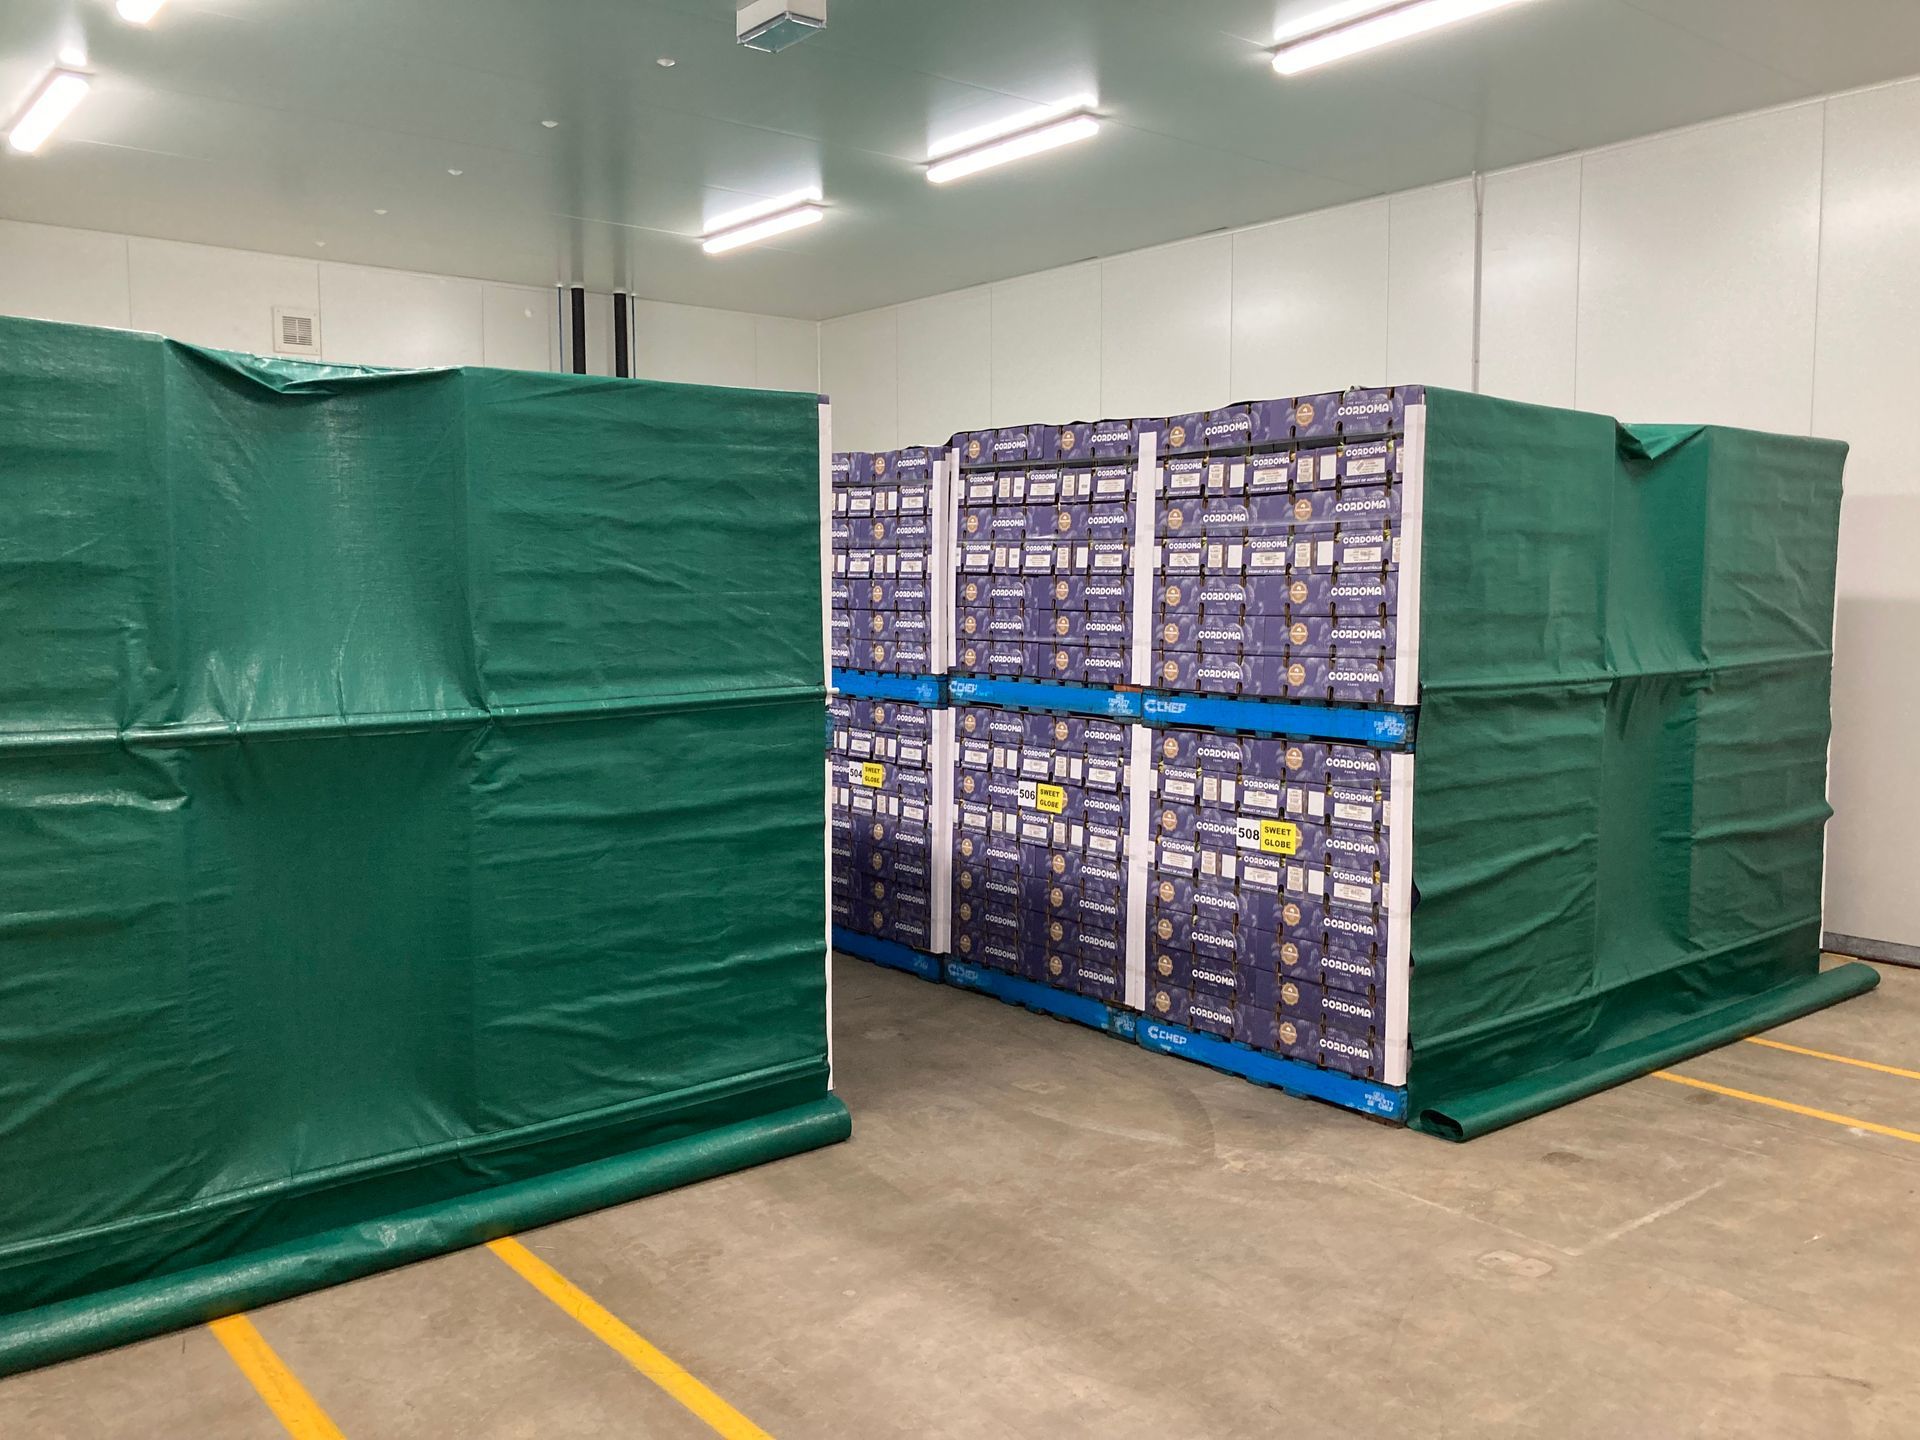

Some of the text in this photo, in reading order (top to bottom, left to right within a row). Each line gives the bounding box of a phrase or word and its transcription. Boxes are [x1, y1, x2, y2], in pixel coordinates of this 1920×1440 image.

[1338, 403, 1389, 416] CORDOMA
[1205, 421, 1248, 436] CORDOMA
[1092, 432, 1128, 442] CORDOMA
[995, 441, 1026, 450] CORDOMA
[1346, 446, 1386, 457] CORDOMA
[1254, 456, 1289, 467] CORDOMA
[1336, 500, 1386, 512] CORDOMA
[1088, 516, 1124, 524] CORDOMA
[1203, 513, 1245, 522] CORDOMA
[1169, 541, 1201, 549] CORDOMA
[1251, 540, 1287, 549] CORDOMA
[1343, 535, 1383, 545] CORDOMA
[1085, 587, 1121, 595] CORDOMA
[1201, 592, 1242, 601] CORDOMA
[1331, 587, 1381, 596] CORDOMA
[1086, 623, 1122, 632] CORDOMA
[1199, 631, 1240, 640] CORDOMA
[1332, 630, 1381, 639] CORDOMA
[990, 655, 1020, 663] CORDOMA
[1085, 659, 1120, 668] CORDOMA
[1198, 669, 1240, 679] CORDOMA
[1329, 672, 1379, 682] CORDOMA
[1158, 702, 1187, 713] CHEP
[990, 722, 1021, 732] CORDOMA
[1085, 731, 1120, 741] CORDOMA
[965, 741, 988, 749] CORDOMA
[1024, 750, 1049, 758] CORDOMA
[1198, 748, 1239, 759] CORDOMA
[1089, 758, 1117, 766] CORDOMA
[1326, 758, 1376, 771] CORDOMA
[850, 769, 862, 778] 504
[1165, 769, 1196, 779] CORDOMA
[1244, 780, 1279, 790] CORDOMA
[1019, 789, 1035, 800] 506
[1040, 789, 1059, 797] SWEET
[1333, 791, 1373, 802] CORDOMA
[1040, 800, 1058, 808] GLOBE
[1084, 800, 1120, 811] CORDOMA
[1022, 814, 1048, 823] CORDOMA
[1090, 826, 1118, 835] CORDOMA
[1238, 829, 1259, 840] 508
[1265, 826, 1291, 836] SWEET
[1162, 841, 1194, 852] CORDOMA
[1265, 839, 1291, 849] GLOBE
[1326, 838, 1375, 851] CORDOMA
[987, 849, 1018, 860] CORDOMA
[1244, 855, 1279, 867] CORDOMA
[1082, 866, 1117, 880] CORDOMA
[1333, 871, 1373, 884] CORDOMA
[986, 882, 1017, 895] CORDOMA
[1080, 900, 1115, 914] CORDOMA
[1194, 893, 1236, 910] CORDOMA
[985, 914, 1016, 927] CORDOMA
[1324, 918, 1373, 935] CORDOMA
[1079, 935, 1115, 949] CORDOMA
[1192, 932, 1233, 948] CORDOMA
[985, 946, 1016, 960] CORDOMA
[1321, 958, 1371, 976] CORDOMA
[1079, 969, 1114, 984] CORDOMA
[1192, 969, 1234, 987] CORDOMA
[1322, 998, 1371, 1018] CORDOMA
[1190, 1006, 1231, 1024] CORDOMA
[1159, 1032, 1186, 1045] CHEP
[1319, 1039, 1369, 1059] CORDOMA
